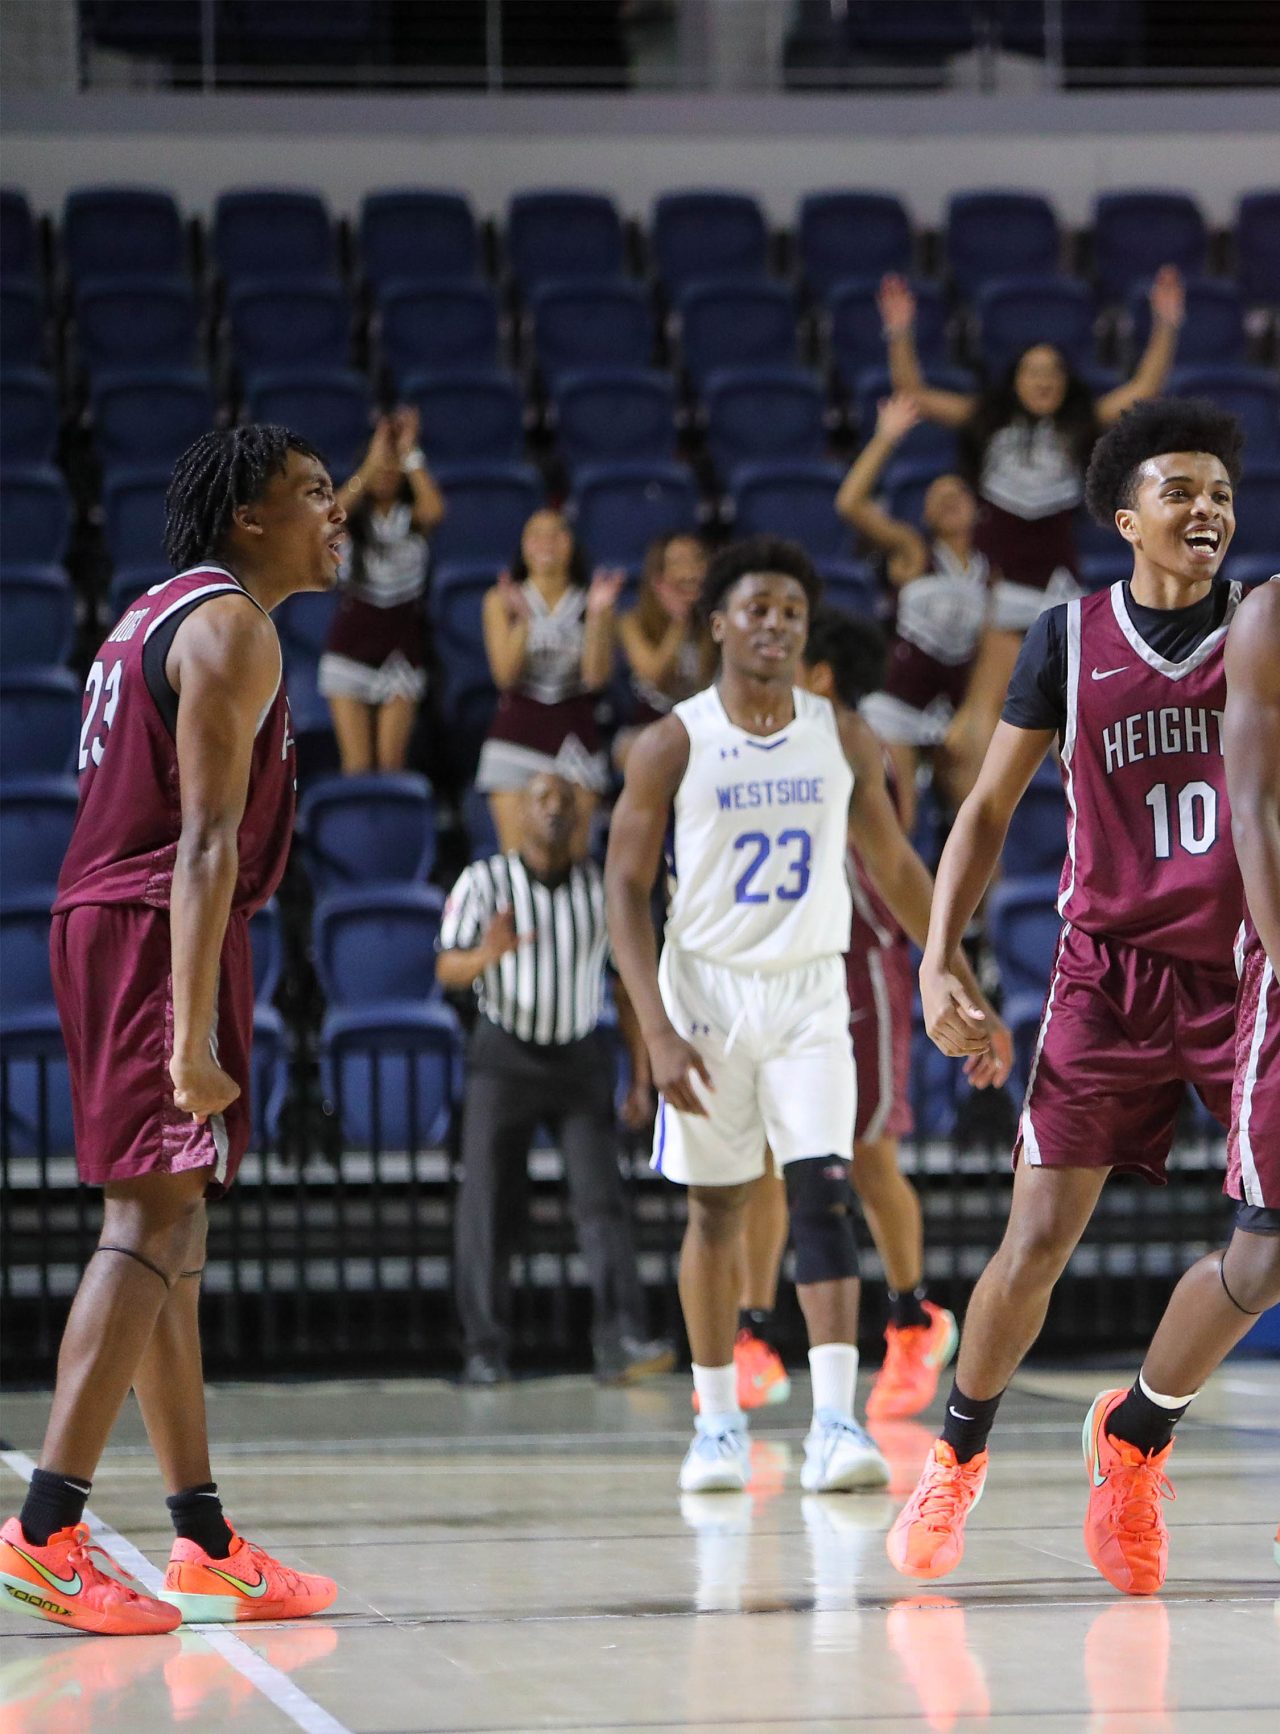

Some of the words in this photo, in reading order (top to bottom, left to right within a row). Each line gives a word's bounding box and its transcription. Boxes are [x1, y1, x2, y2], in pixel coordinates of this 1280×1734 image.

[78, 661, 122, 770] 23
[716, 777, 824, 811] WESTSIDE
[1145, 781, 1216, 858] 10
[734, 829, 811, 904] 23
